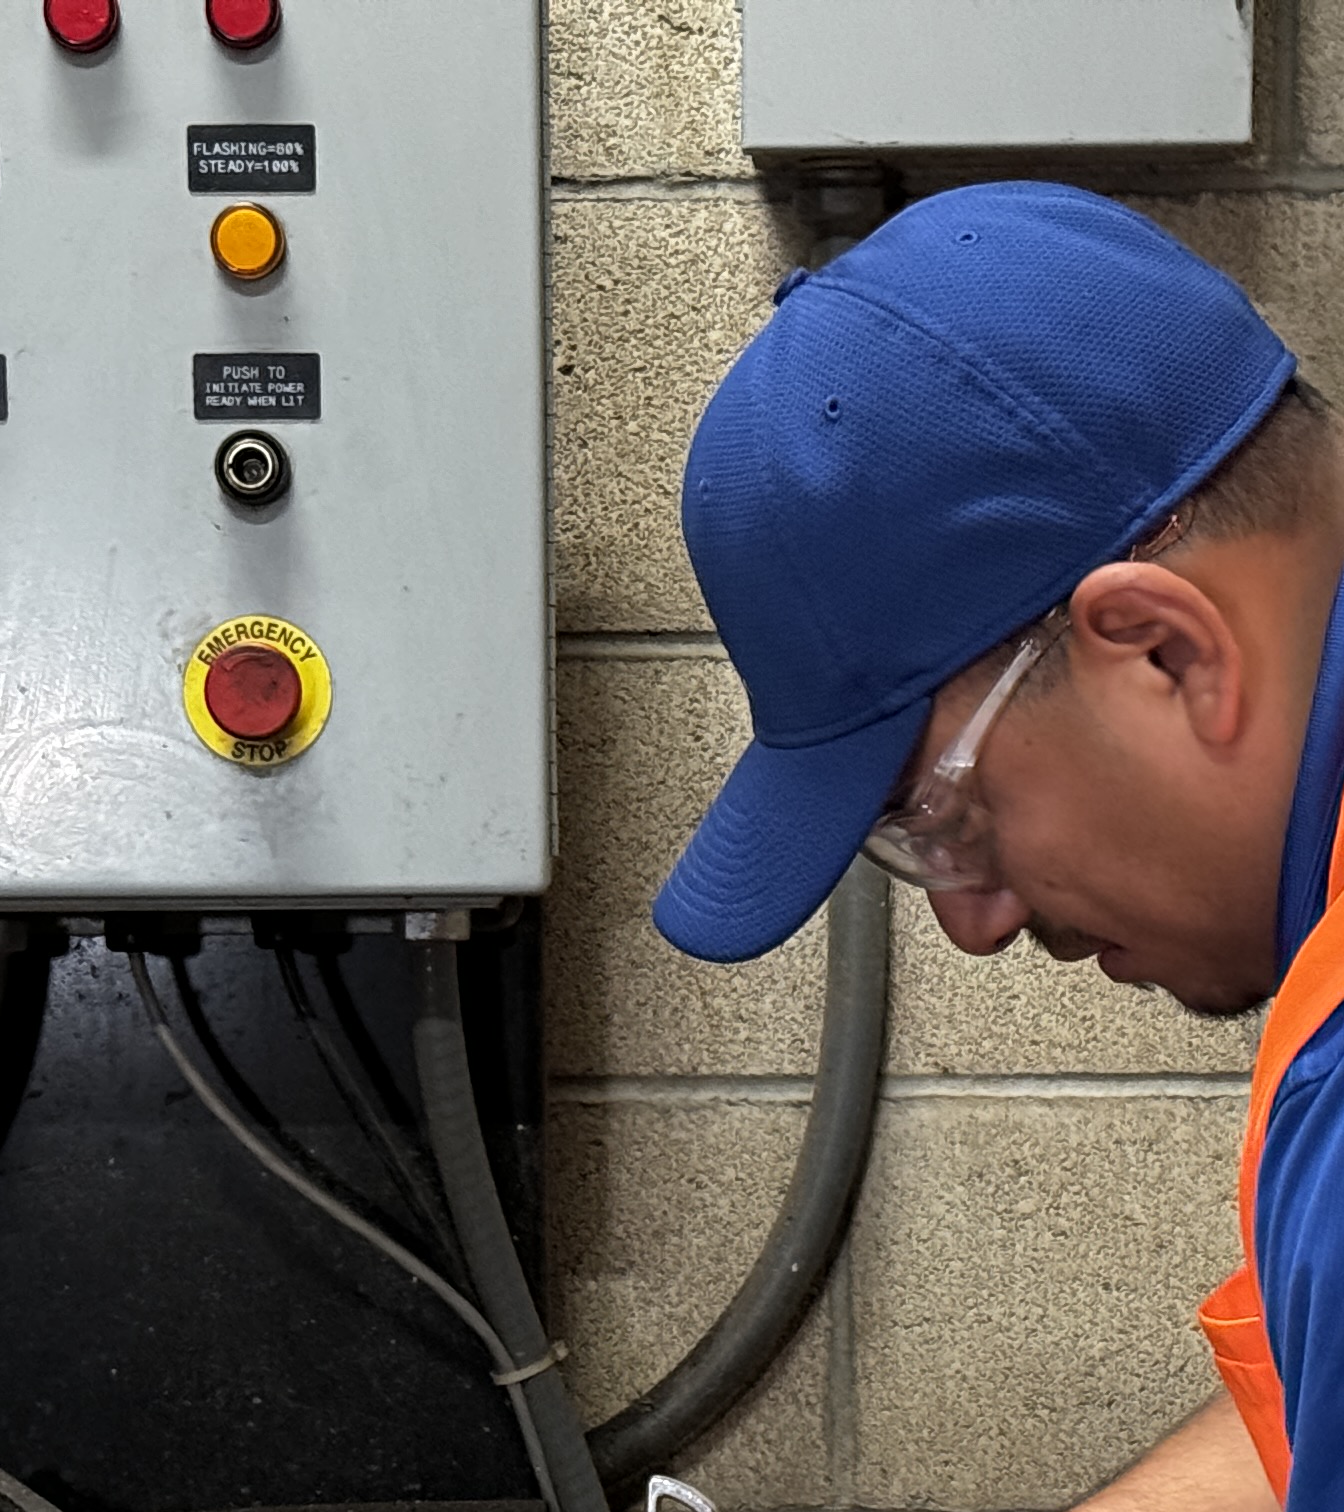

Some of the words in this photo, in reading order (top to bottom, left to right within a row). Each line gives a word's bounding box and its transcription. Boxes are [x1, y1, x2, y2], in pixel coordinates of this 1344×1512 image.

[199, 160, 300, 174] STEADY=100%
[223, 366, 259, 379] PUSH
[267, 366, 286, 379] TO
[205, 383, 263, 393] INITIATE
[268, 383, 305, 393] POWER
[205, 396, 242, 406] READY
[247, 396, 276, 407] WHEN
[281, 396, 305, 406] LIT
[197, 621, 318, 667] EMERGENCY
[231, 740, 288, 762] STOP
